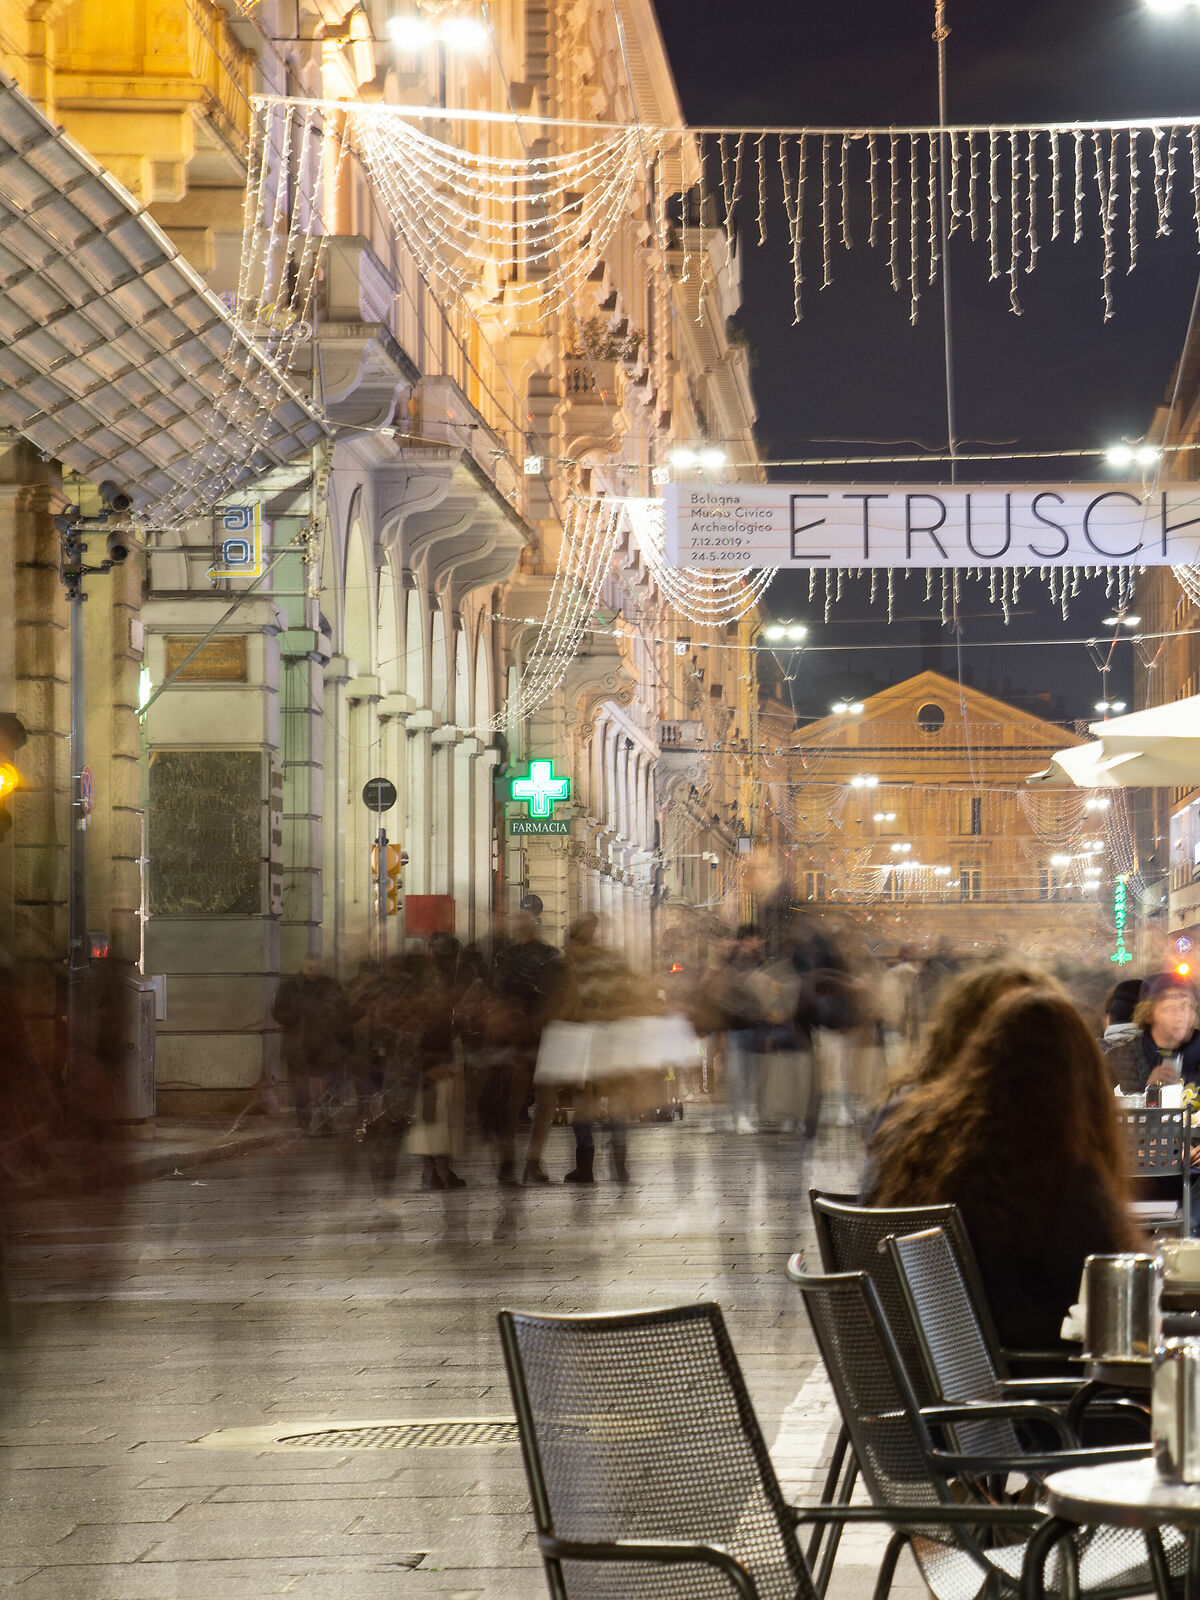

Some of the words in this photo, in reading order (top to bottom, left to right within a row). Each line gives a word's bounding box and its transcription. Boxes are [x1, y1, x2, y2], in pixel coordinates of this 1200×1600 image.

[691, 493, 740, 506] Bologna
[735, 508, 773, 518] Civico
[691, 523, 773, 535] Archeologico
[691, 538, 742, 547] 7.12.2019
[691, 552, 751, 561] 24.5.2020
[512, 822, 568, 833] FARMACIA
